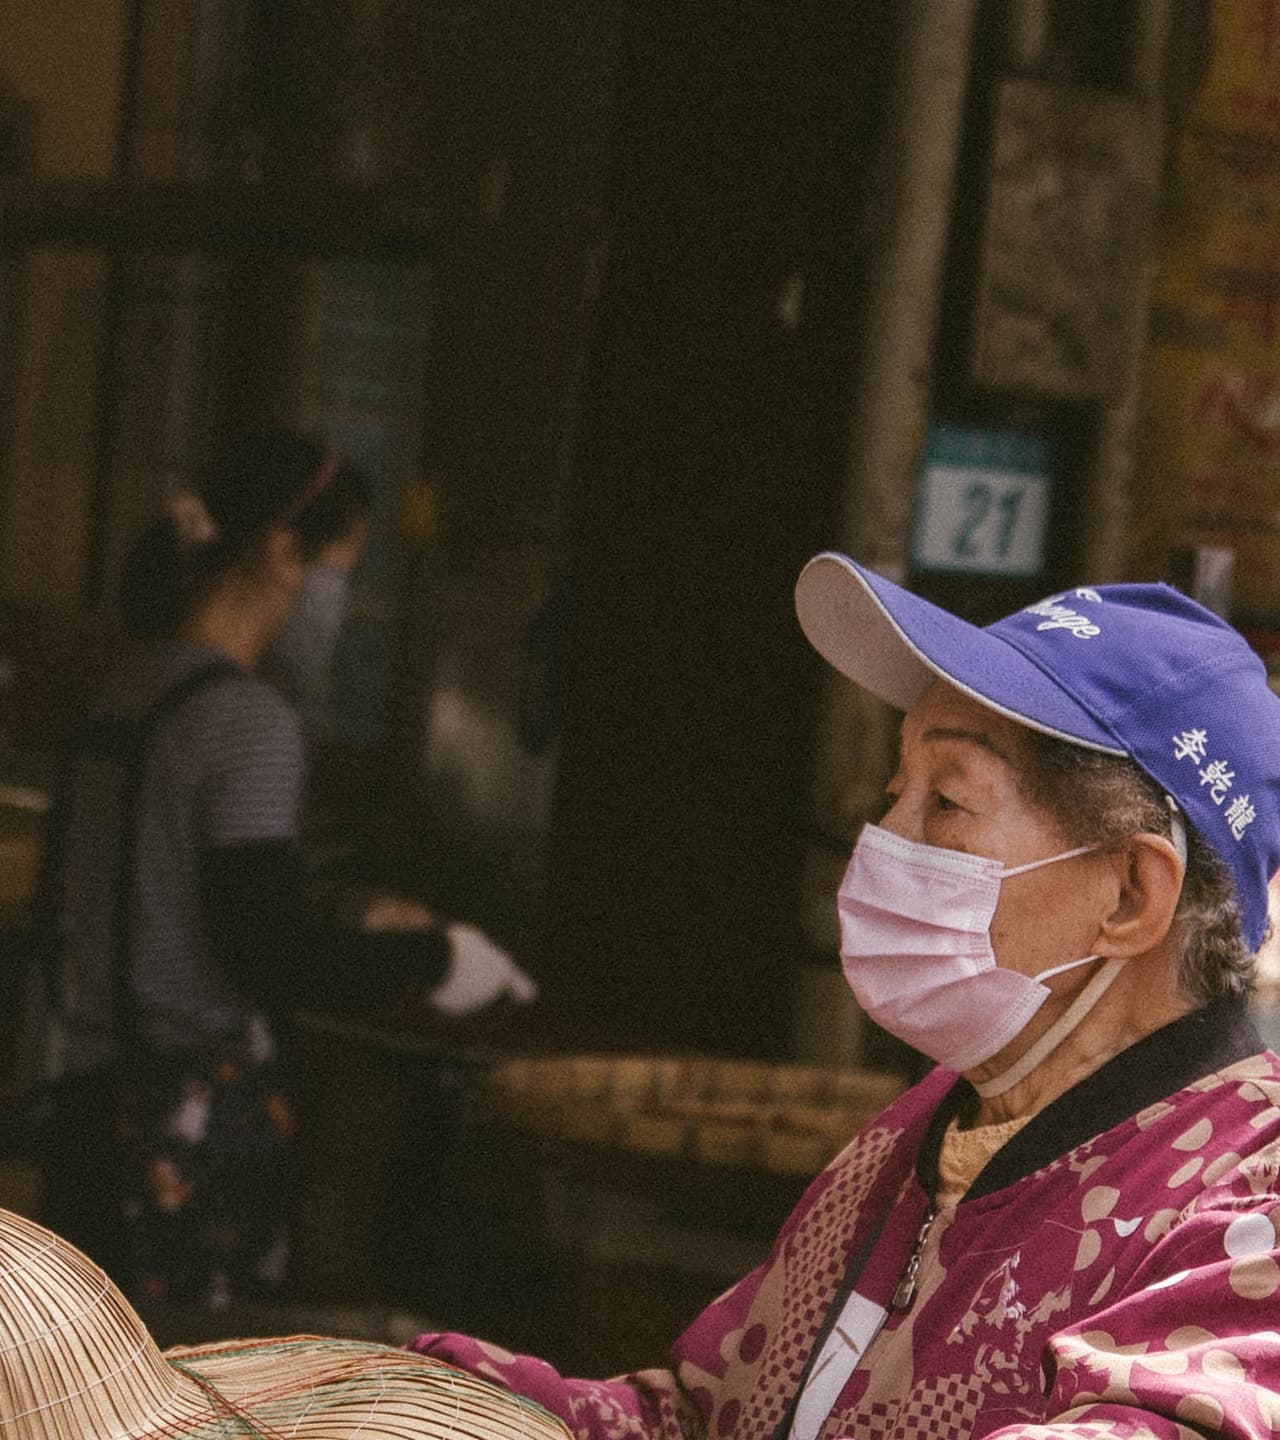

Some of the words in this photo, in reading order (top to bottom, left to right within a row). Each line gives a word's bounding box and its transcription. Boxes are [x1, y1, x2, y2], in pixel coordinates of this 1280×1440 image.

[952, 482, 1024, 557] 21
[1172, 728, 1257, 841] 李乾龍
